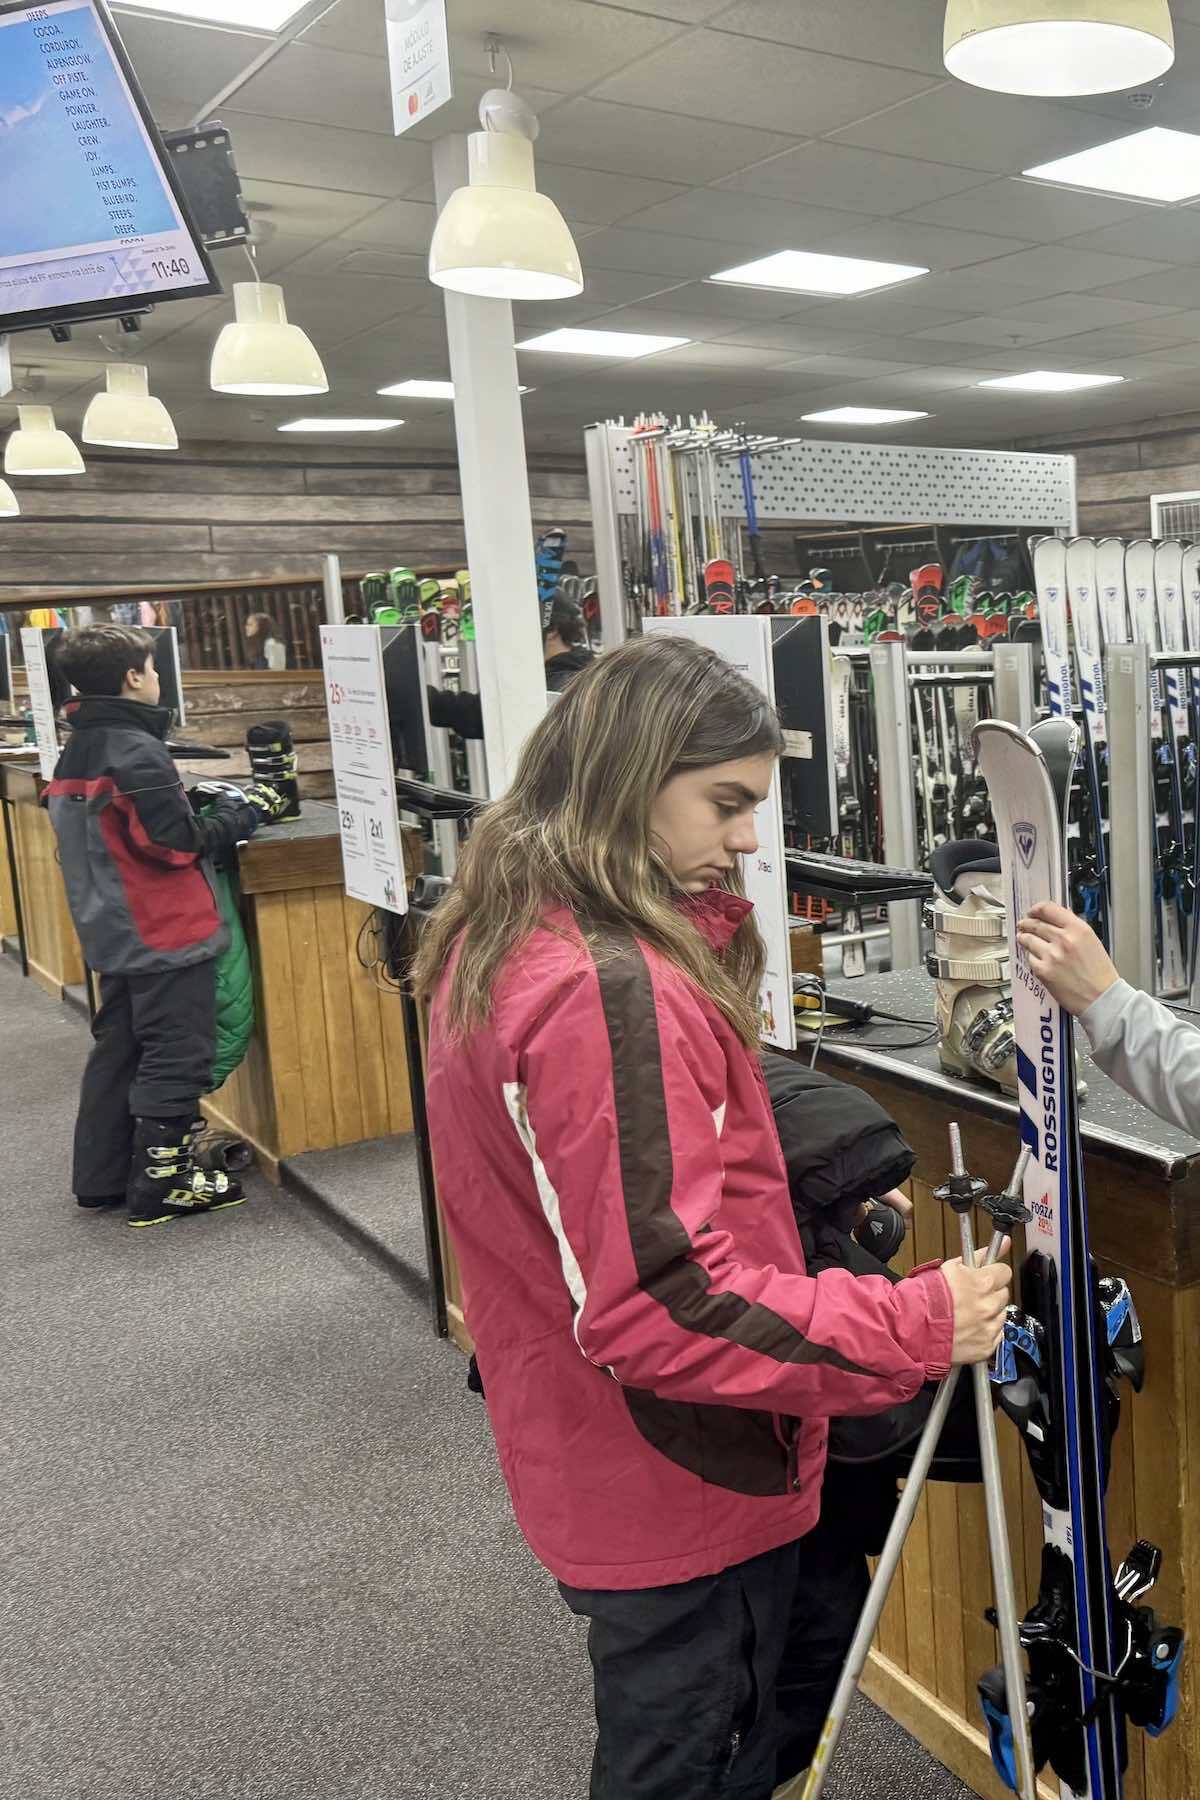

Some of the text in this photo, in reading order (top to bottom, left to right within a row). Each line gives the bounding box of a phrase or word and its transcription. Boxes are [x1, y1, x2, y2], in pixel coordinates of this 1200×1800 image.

[40, 40, 83, 54] CORDUROY.
[47, 54, 95, 70] ALPENGLOW.
[53, 74, 66, 85] OFF
[59, 88, 82, 100] GAME
[72, 118, 112, 131] LAUGHTER.
[78, 136, 102, 146] CREW.
[152, 258, 190, 279] 11:40
[1092, 662, 1104, 714] ROSSIGNOL
[1040, 1007, 1058, 1172] ROSSIGNOL
[1032, 1201, 1053, 1220] FORZA
